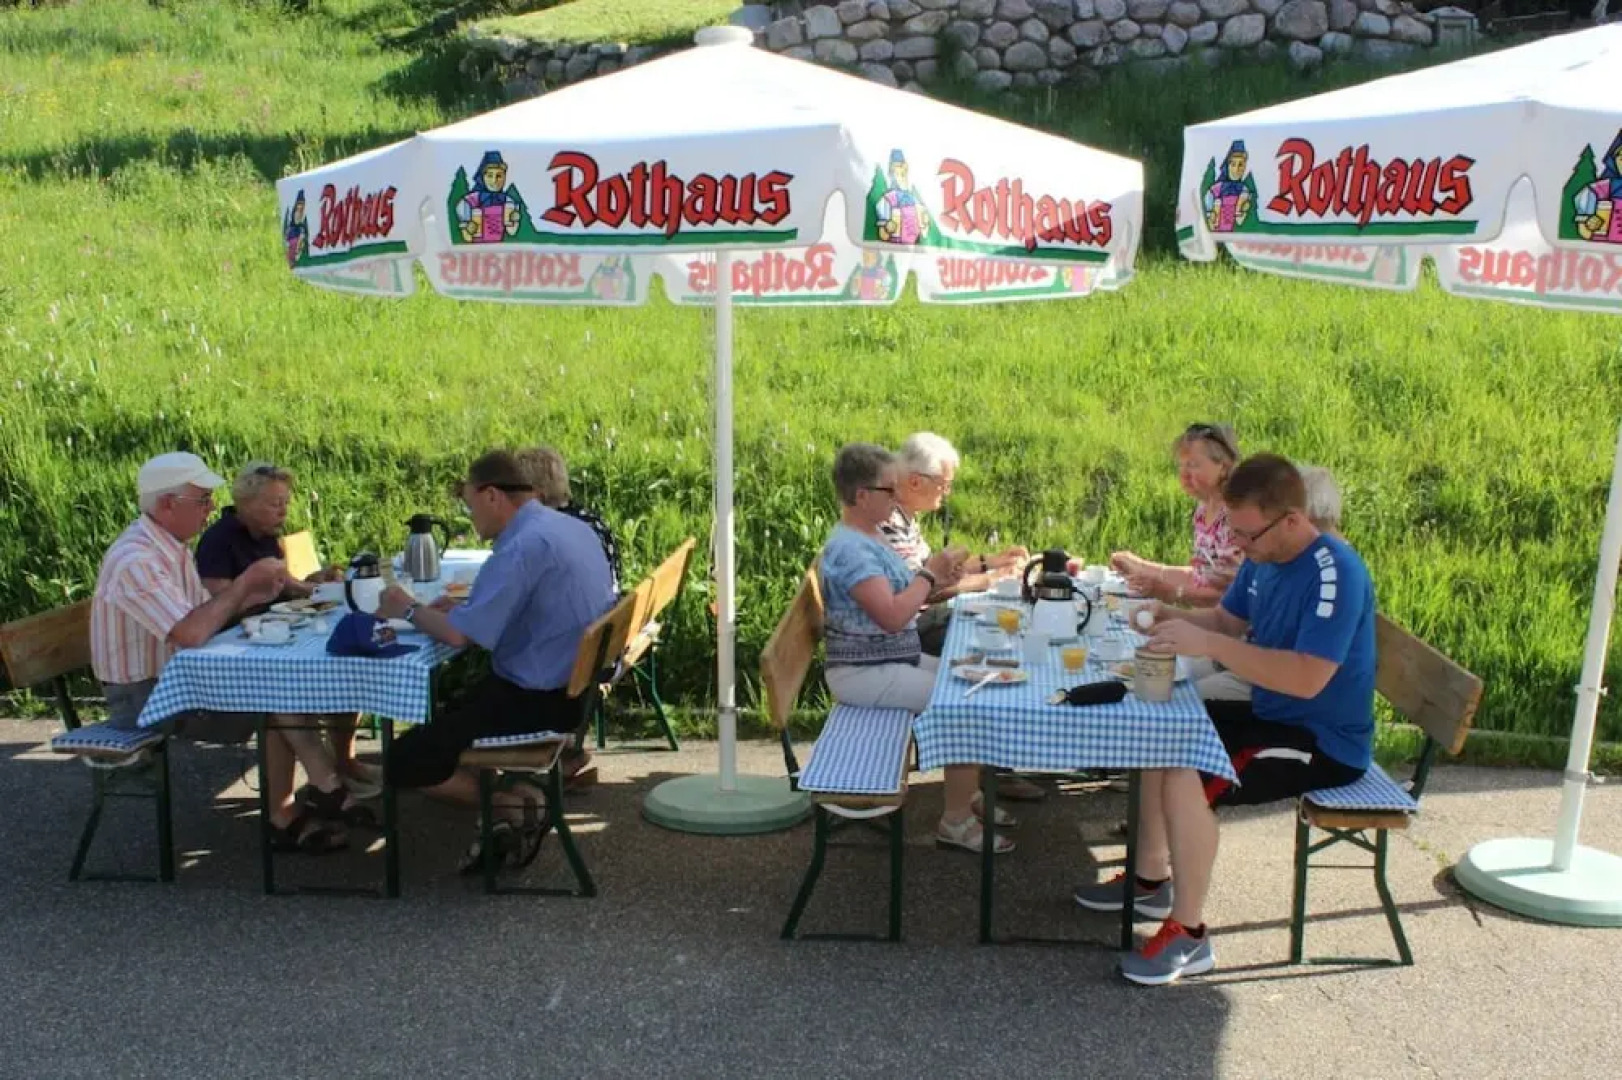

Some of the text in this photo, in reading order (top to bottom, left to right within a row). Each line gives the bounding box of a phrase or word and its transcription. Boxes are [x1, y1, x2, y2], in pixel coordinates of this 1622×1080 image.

[312, 183, 397, 248] Rothaus
[543, 150, 795, 239] Rothaus
[937, 157, 1112, 253] Rothaus
[1266, 137, 1477, 227] Rothaus
